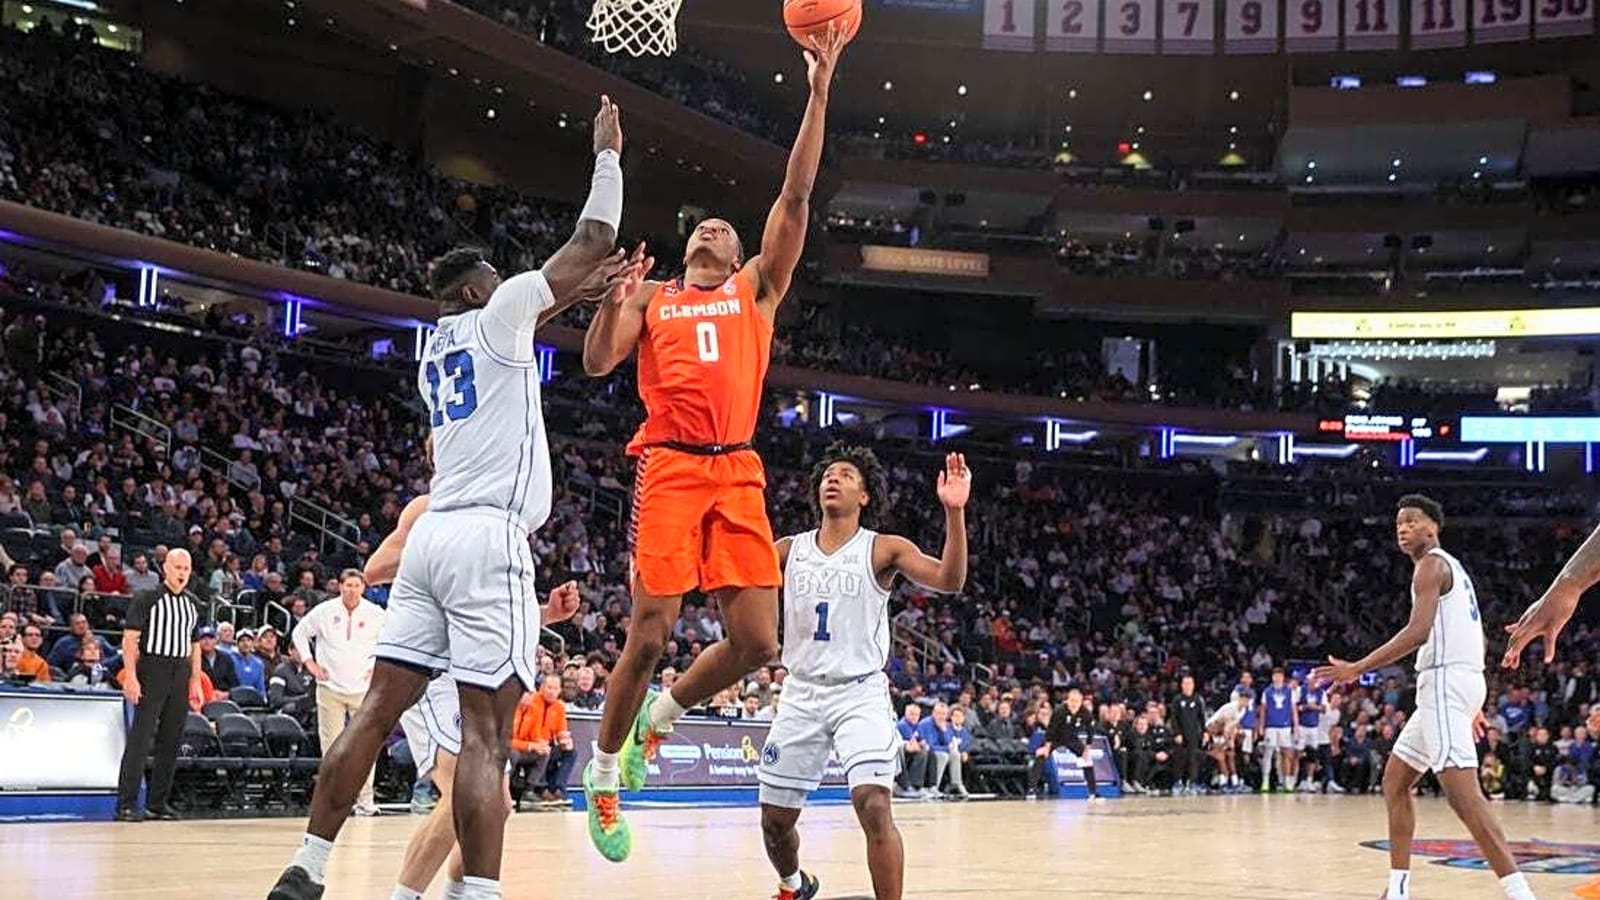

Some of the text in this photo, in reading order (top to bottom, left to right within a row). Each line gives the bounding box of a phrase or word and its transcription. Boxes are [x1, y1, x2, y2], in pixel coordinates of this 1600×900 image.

[1001, 0, 1016, 32] 1
[1062, 0, 1082, 33] 2
[1120, 1, 1141, 35] 3
[1177, 1, 1198, 36] 7
[1241, 1, 1262, 35] 9
[1300, 0, 1322, 33] 9
[1354, 0, 1388, 32] 11
[1421, 0, 1454, 30] 11
[659, 298, 742, 320] CLEMSON
[695, 321, 720, 362] 0
[425, 348, 478, 428] 13
[792, 567, 862, 598] BYU
[813, 601, 831, 641] 1
[703, 743, 744, 760] Pension
